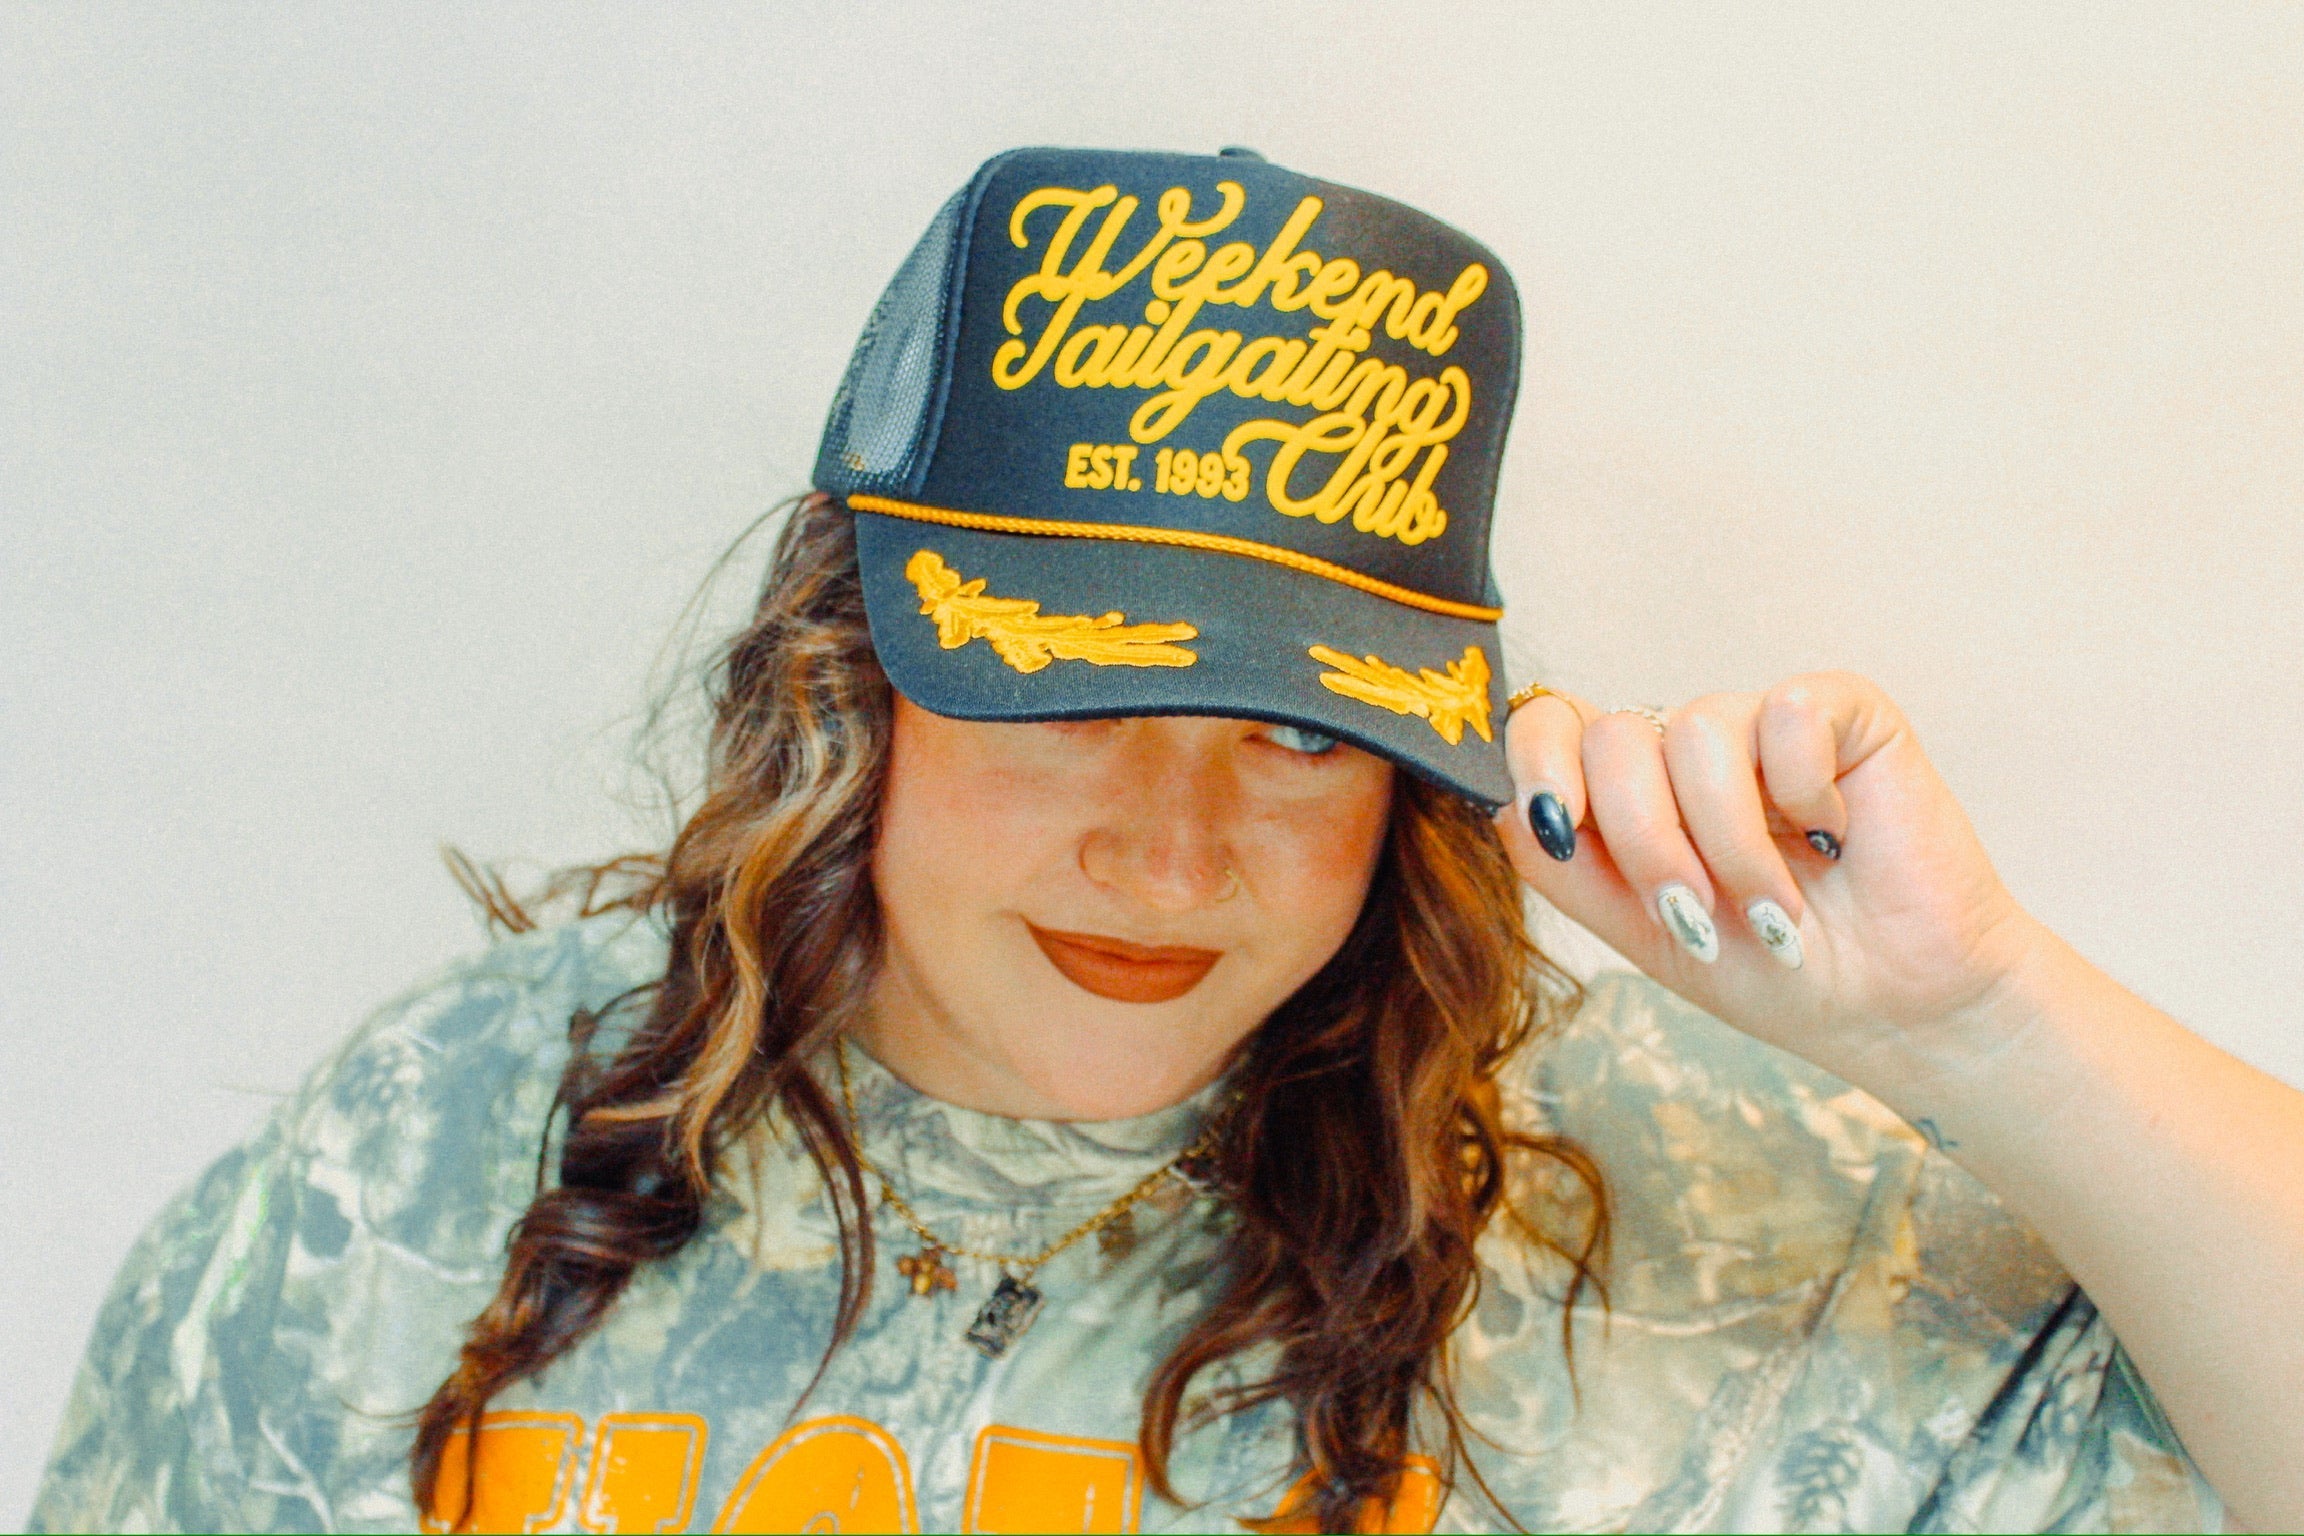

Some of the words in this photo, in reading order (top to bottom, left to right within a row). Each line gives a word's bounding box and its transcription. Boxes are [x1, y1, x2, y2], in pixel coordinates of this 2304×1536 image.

[1009, 180, 1488, 357] Weekend
[992, 272, 1472, 472] Tailgating
[1064, 443, 1140, 492] EST.
[1155, 447, 1250, 502] 1993
[1222, 411, 1448, 546] Club
